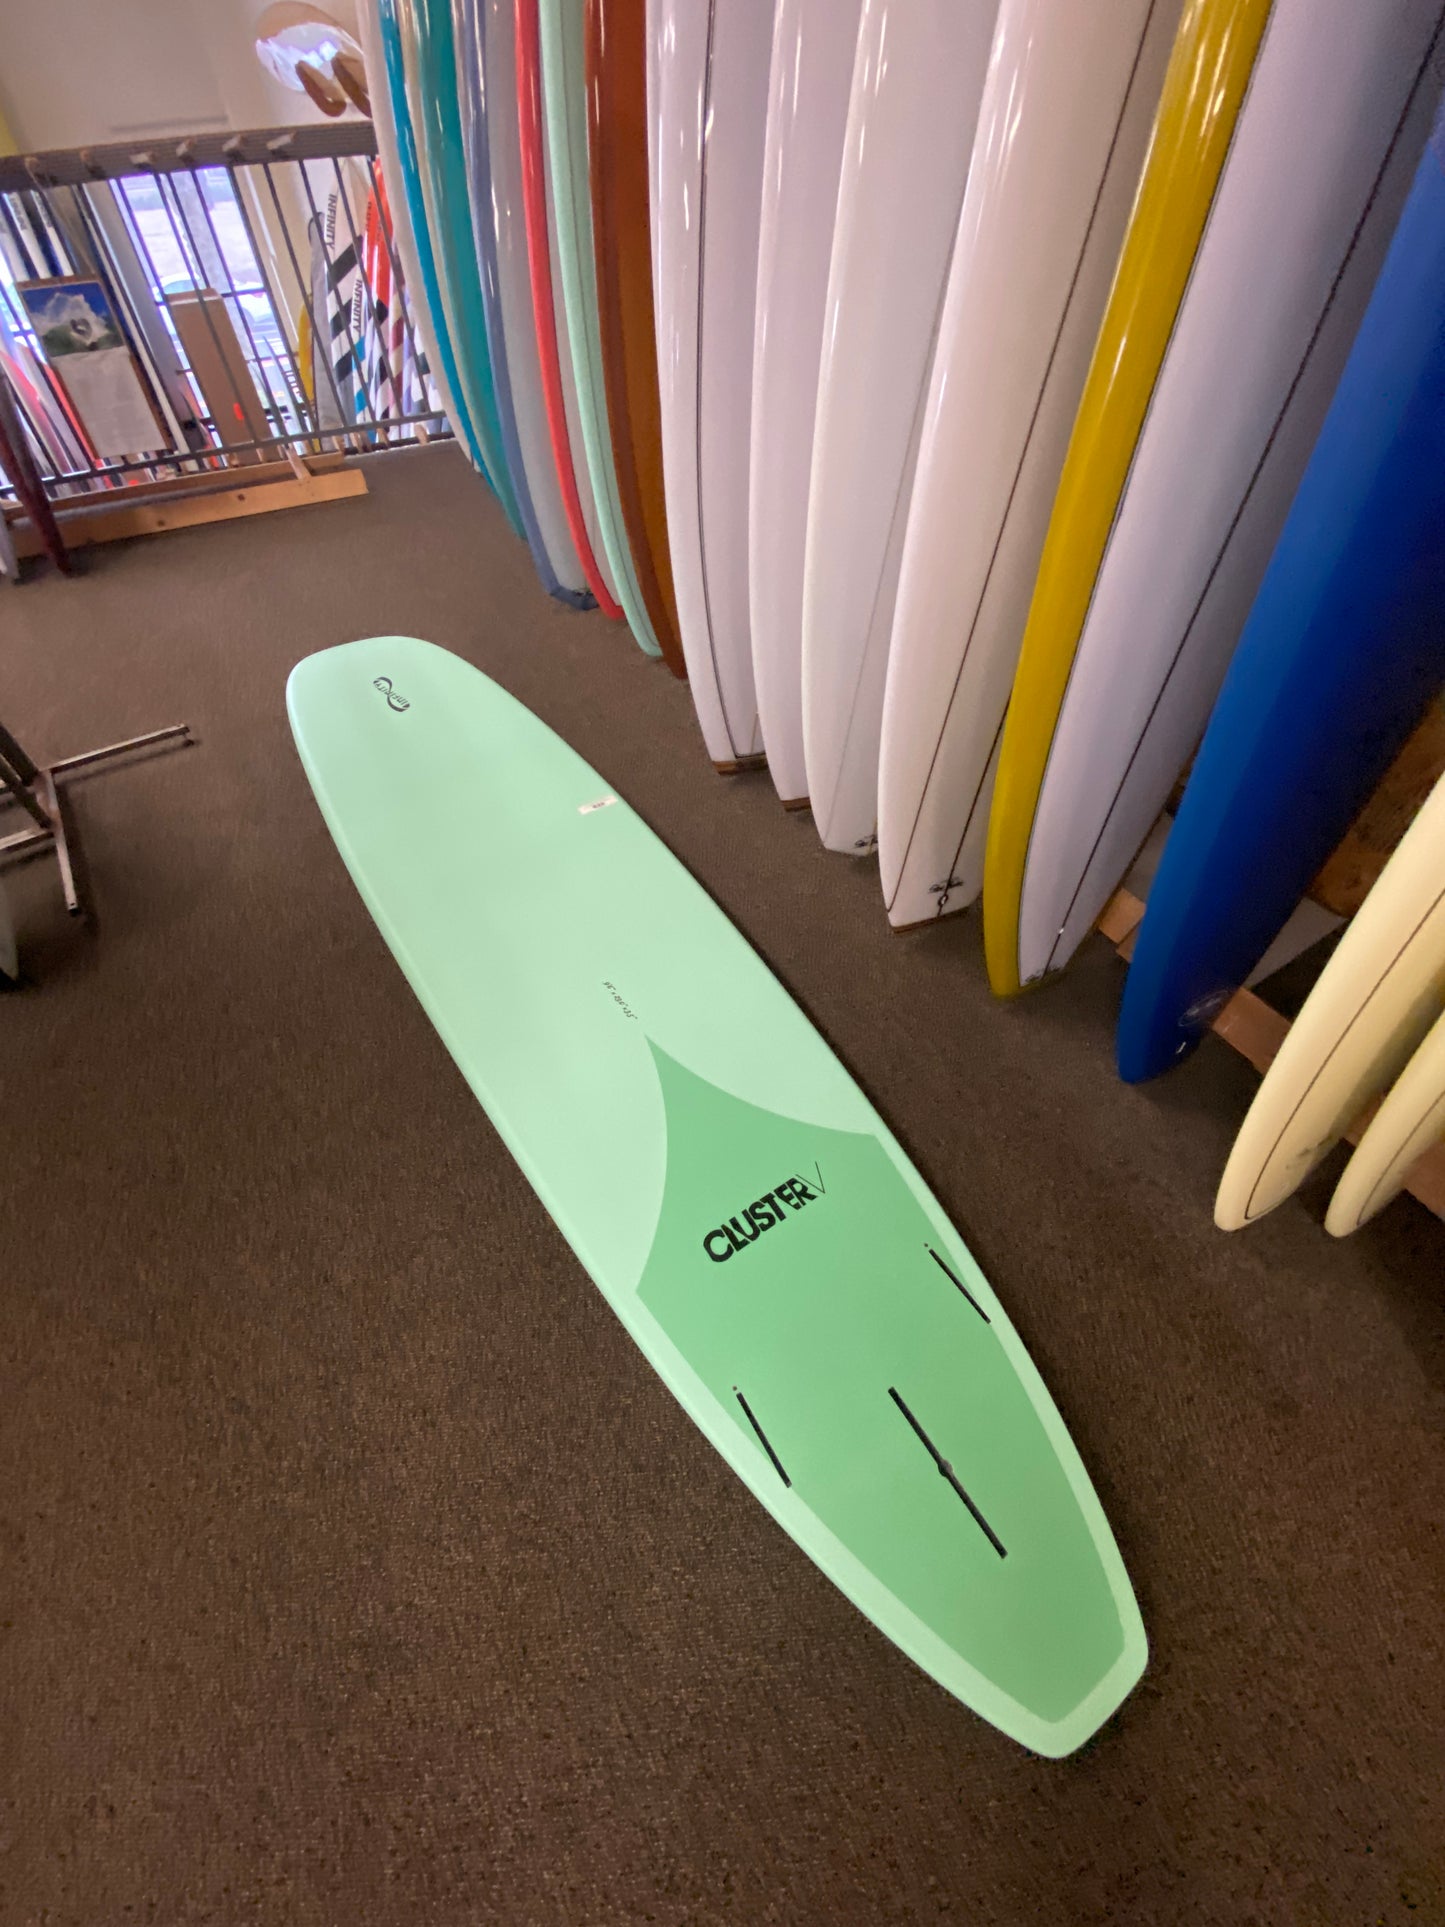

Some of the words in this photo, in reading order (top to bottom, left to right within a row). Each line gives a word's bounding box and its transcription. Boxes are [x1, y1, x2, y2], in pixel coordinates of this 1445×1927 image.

[325, 194, 337, 250] INFINITY
[352, 279, 363, 333] INFINITY
[703, 1177, 818, 1263] CLUSTER
